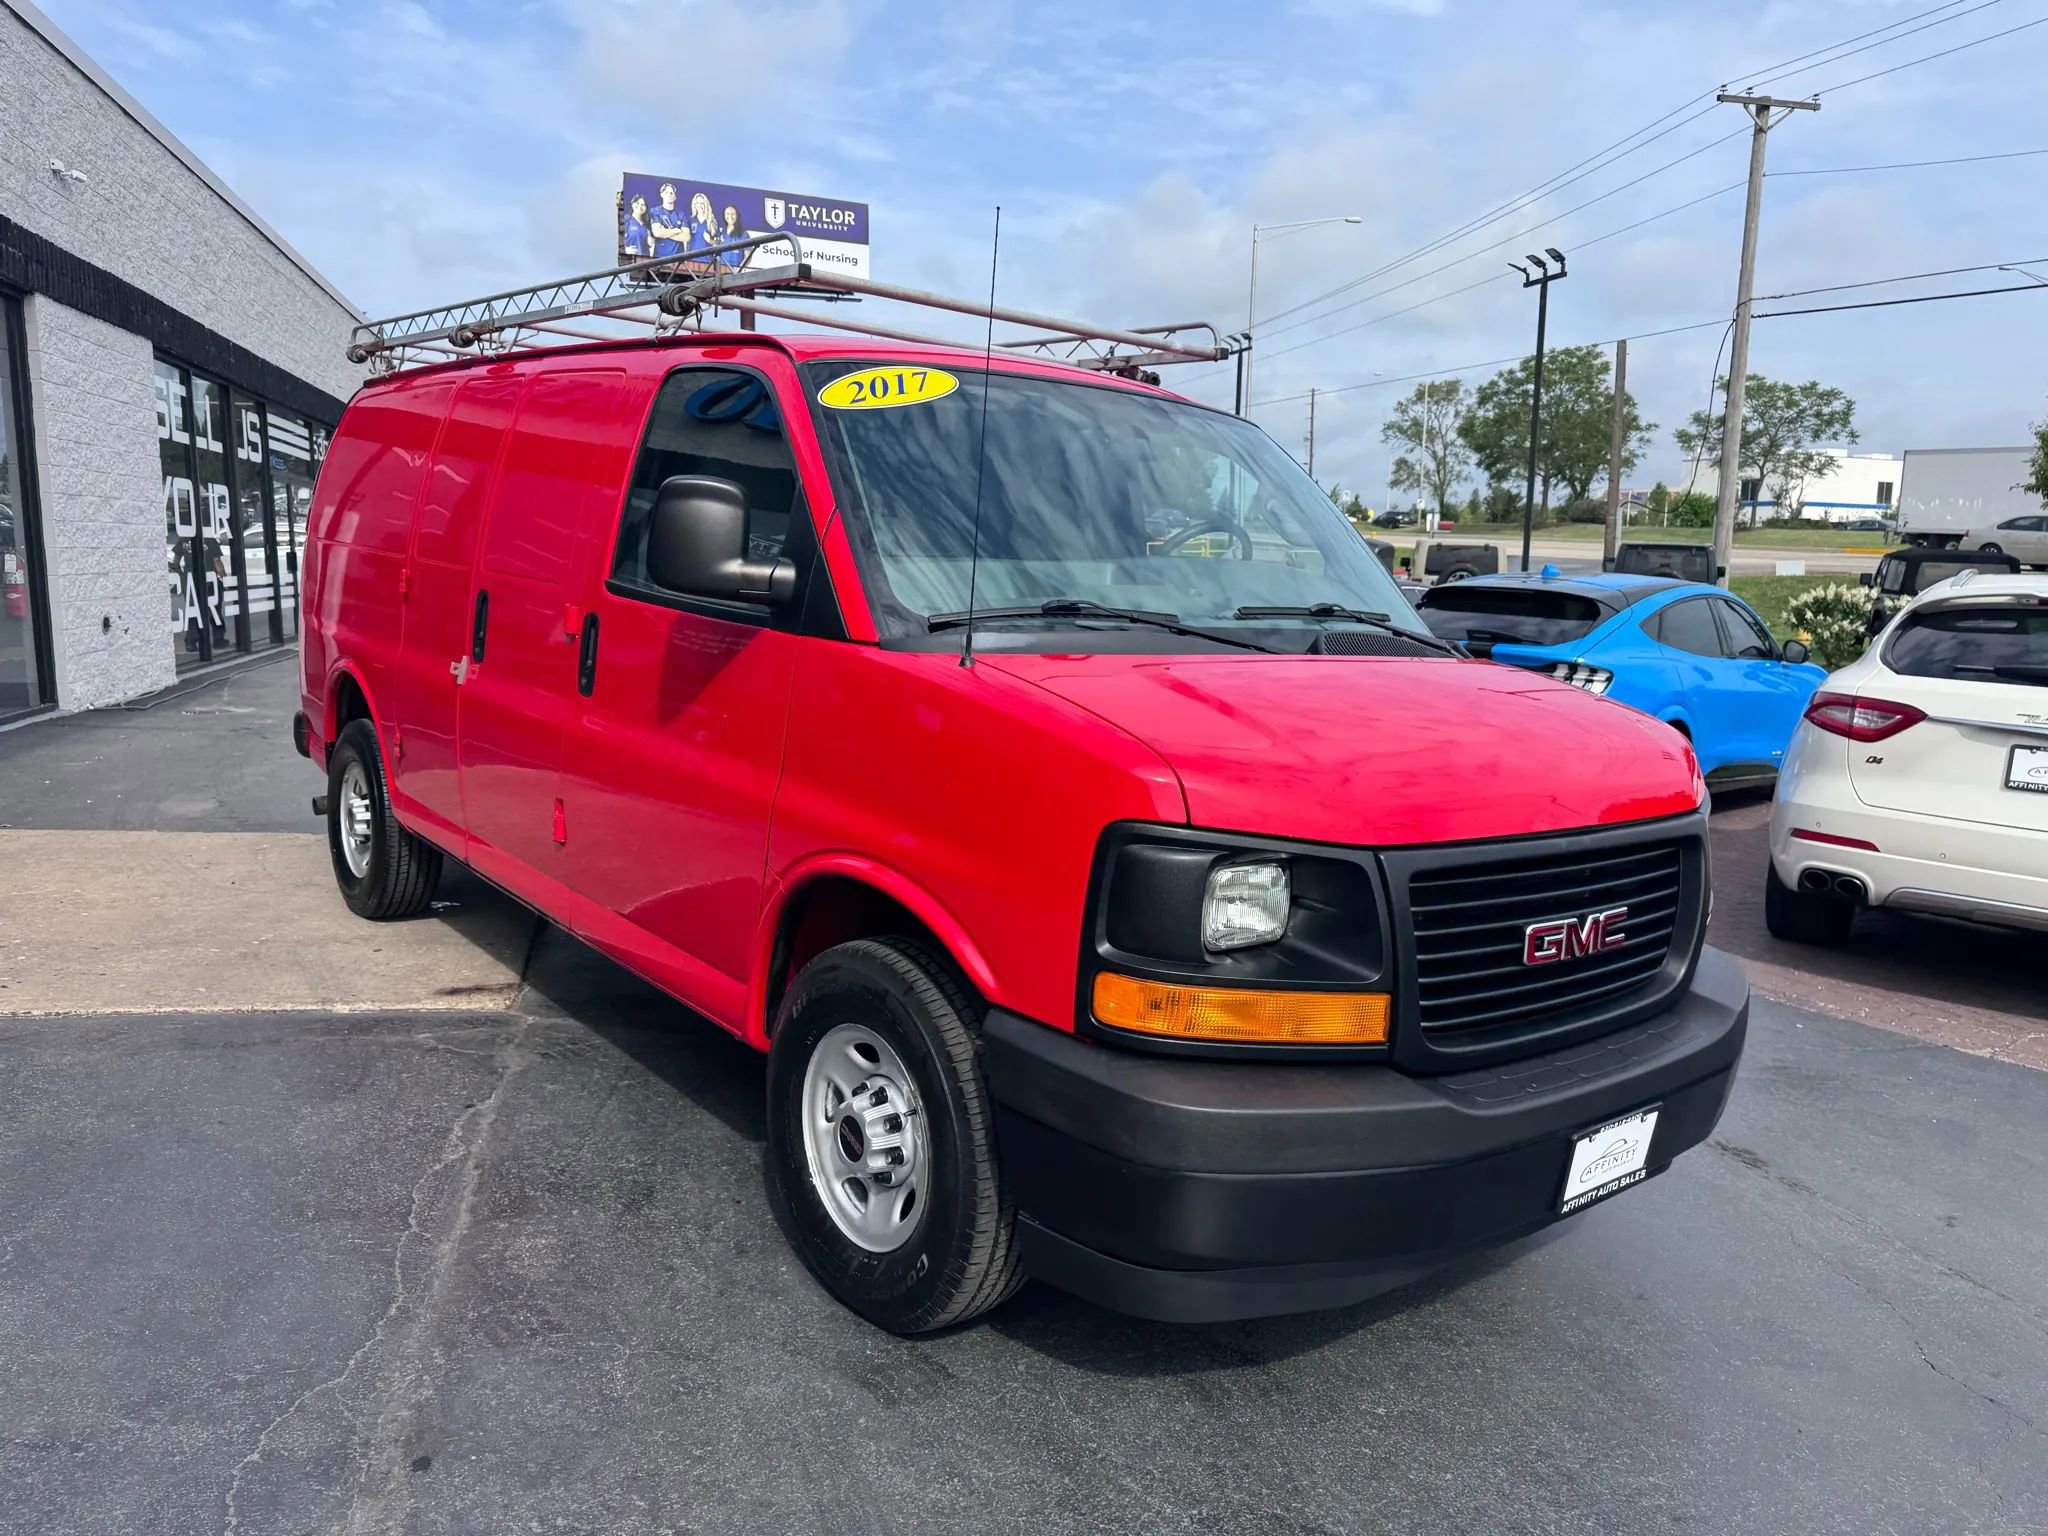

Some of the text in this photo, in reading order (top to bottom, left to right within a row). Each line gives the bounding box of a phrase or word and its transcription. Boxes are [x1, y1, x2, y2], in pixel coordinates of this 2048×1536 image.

[788, 203, 856, 226] TAYLOR
[796, 220, 849, 232] UNIVERSITY
[762, 245, 858, 266] Schoo of Nursing
[847, 371, 928, 405] 2017
[2008, 780, 2048, 792] AFFINITY
[1523, 906, 1628, 966] GMC
[1585, 1147, 1638, 1176] AFFINITY
[1561, 1169, 1647, 1214] AFFINITY AUTO SALES
